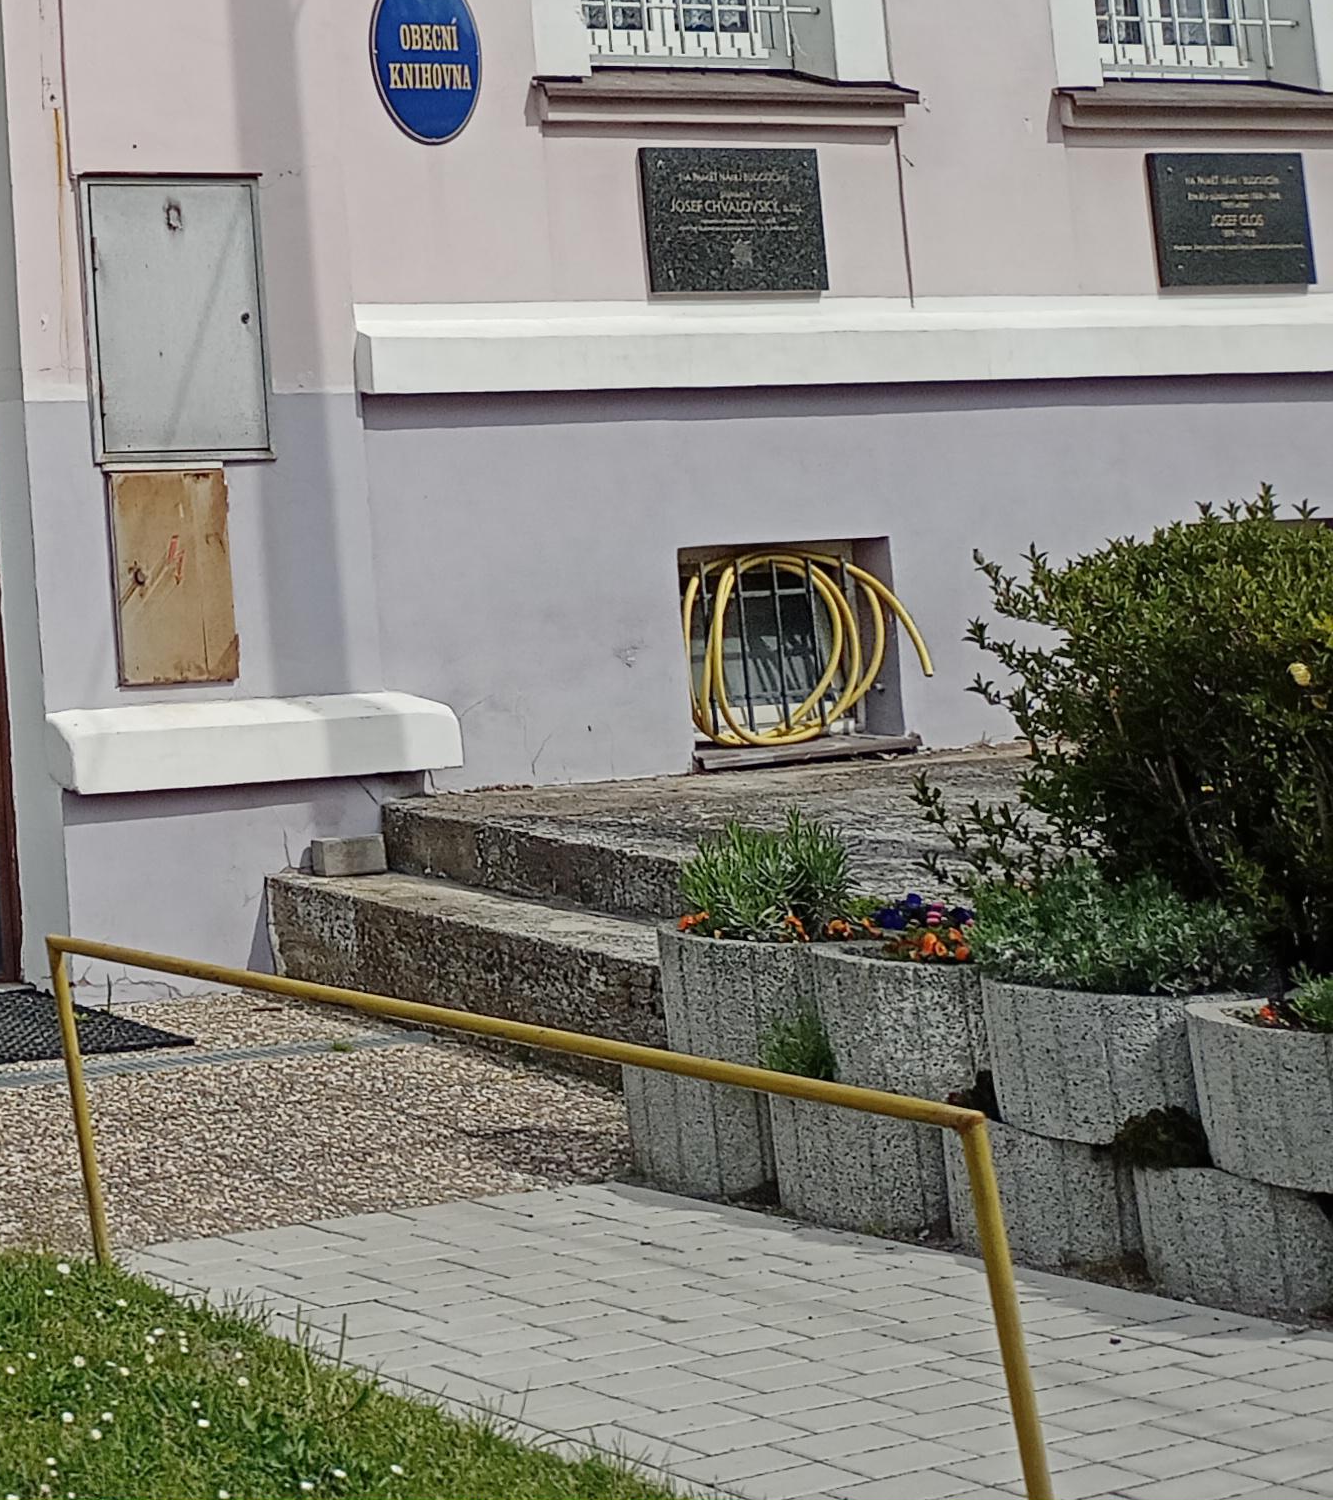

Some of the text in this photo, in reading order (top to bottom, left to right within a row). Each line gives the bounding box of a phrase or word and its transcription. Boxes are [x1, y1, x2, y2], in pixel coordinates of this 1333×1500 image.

[399, 17, 459, 51] OBECNÍ
[389, 63, 472, 90] KNIHOVNA
[670, 197, 703, 213] JOSEF
[1211, 214, 1237, 227] JOSEF
